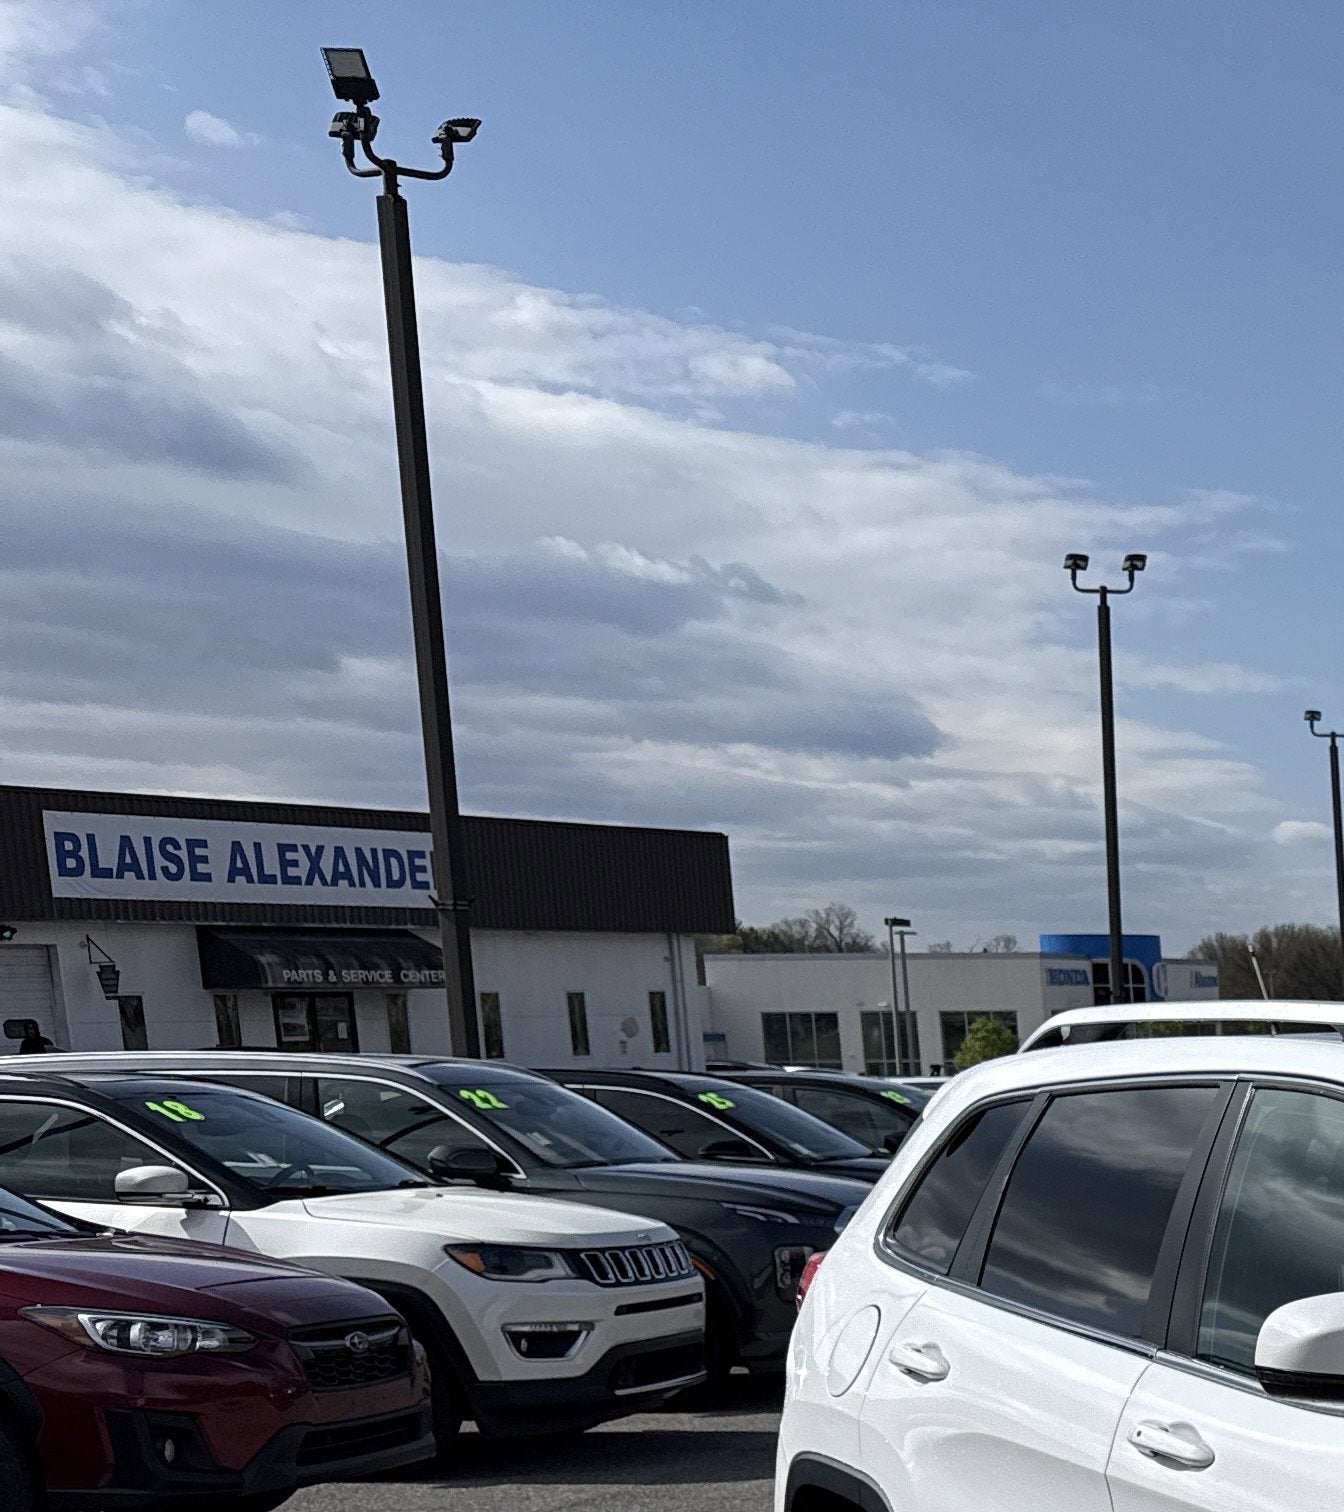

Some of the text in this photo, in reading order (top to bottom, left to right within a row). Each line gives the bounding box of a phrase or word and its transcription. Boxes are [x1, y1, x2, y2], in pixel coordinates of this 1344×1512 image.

[53, 831, 438, 892] BLAISE ALEXANDE
[282, 969, 446, 983] PARTS & SERVICE CENTER
[458, 1088, 511, 1110] 22
[144, 1099, 206, 1123] 18
